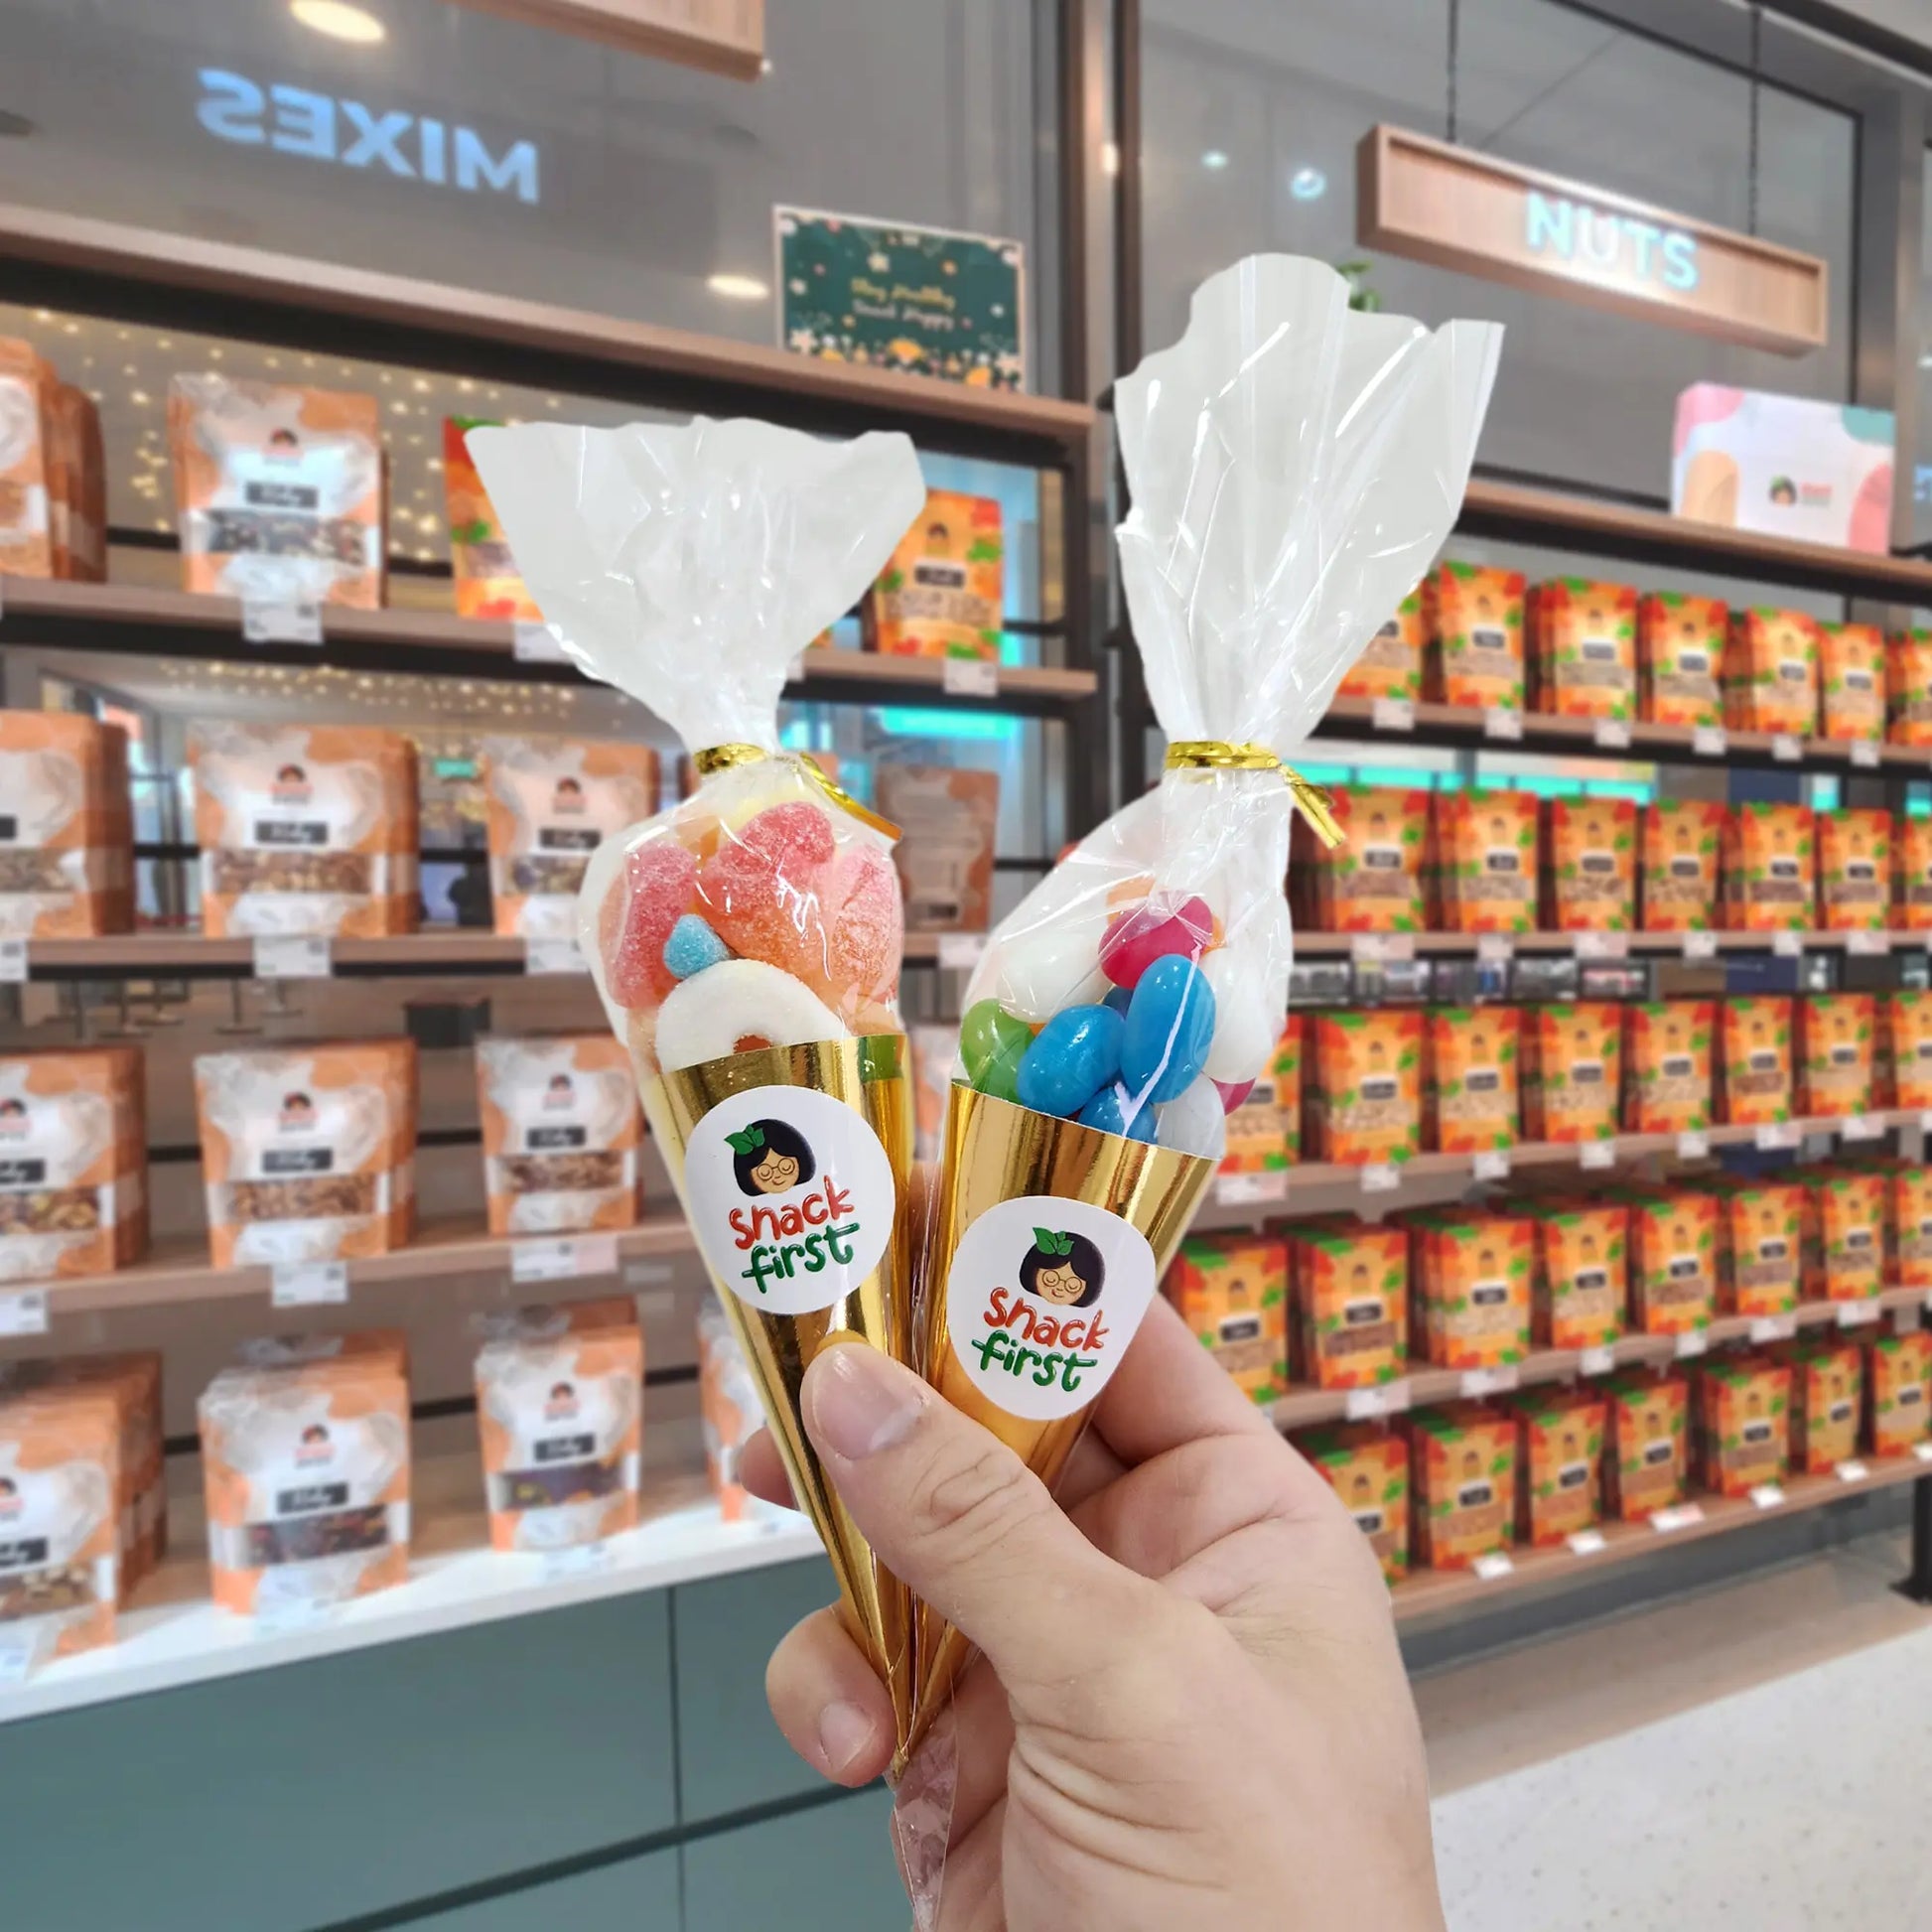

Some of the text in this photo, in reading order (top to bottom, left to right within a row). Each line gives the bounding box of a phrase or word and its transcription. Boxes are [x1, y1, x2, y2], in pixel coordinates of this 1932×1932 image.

[1526, 190, 1700, 292] NUTS
[741, 1222, 861, 1295] first
[971, 1329, 1098, 1392] first
